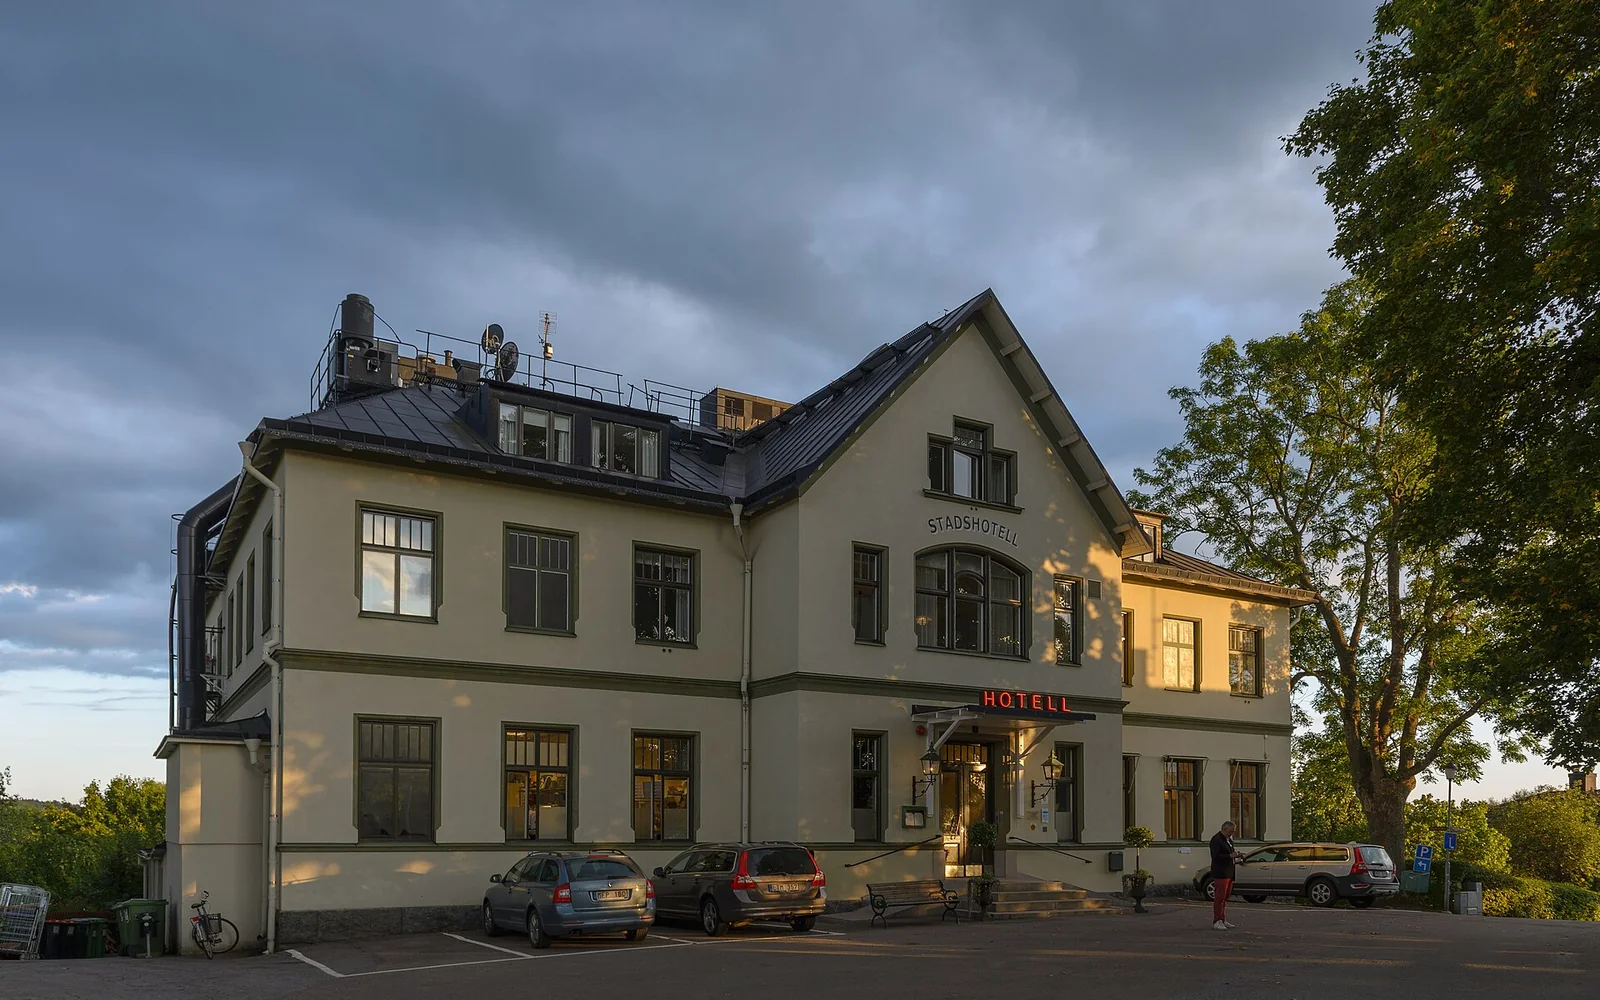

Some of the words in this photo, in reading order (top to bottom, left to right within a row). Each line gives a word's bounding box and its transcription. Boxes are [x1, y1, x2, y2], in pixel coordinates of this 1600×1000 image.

[928, 515, 1018, 547] STADSHOTELL
[983, 690, 1071, 712] HOTELL
[1420, 846, 1429, 857] P
